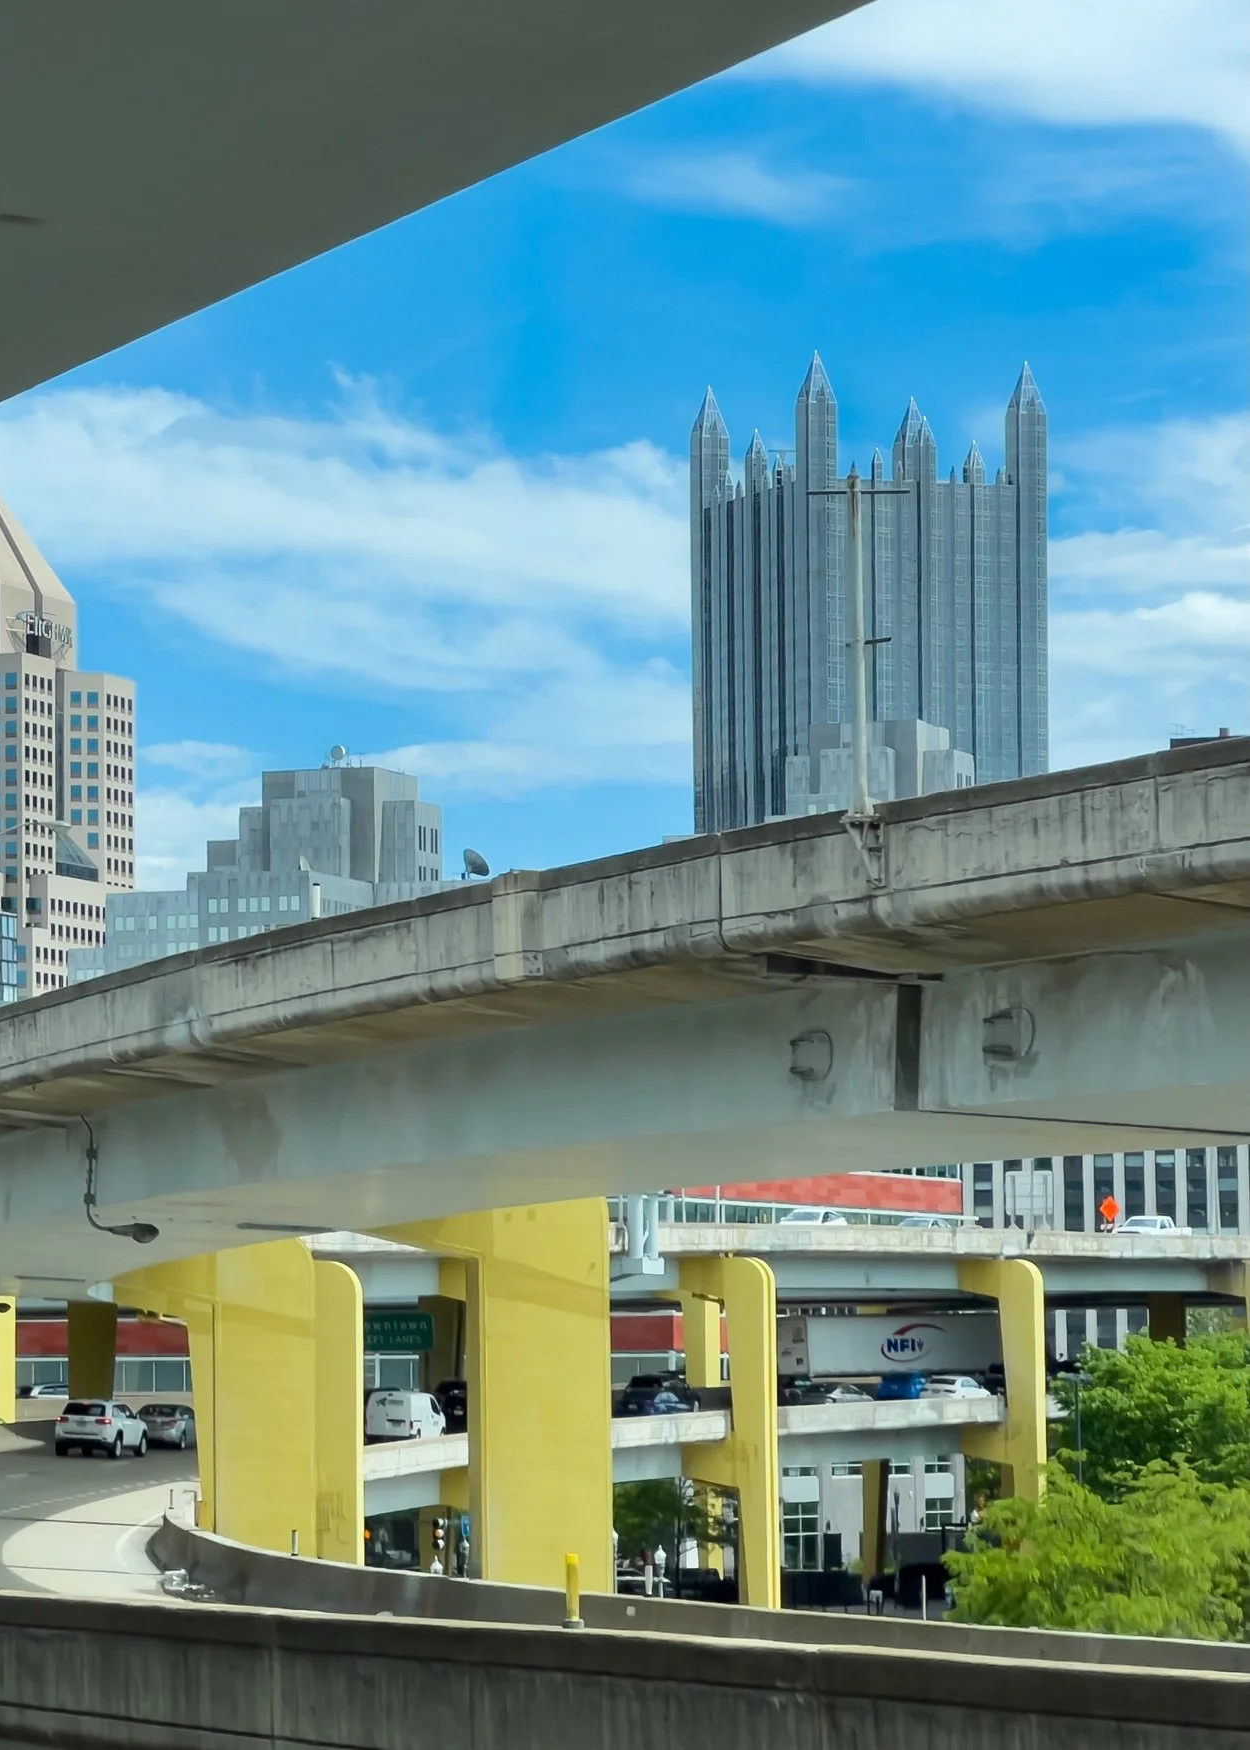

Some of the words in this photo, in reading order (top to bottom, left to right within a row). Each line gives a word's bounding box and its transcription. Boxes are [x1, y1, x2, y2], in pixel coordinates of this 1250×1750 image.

[365, 1319, 427, 1331] owntown
[366, 1335, 384, 1345] EFT
[886, 1338, 916, 1353] NFI
